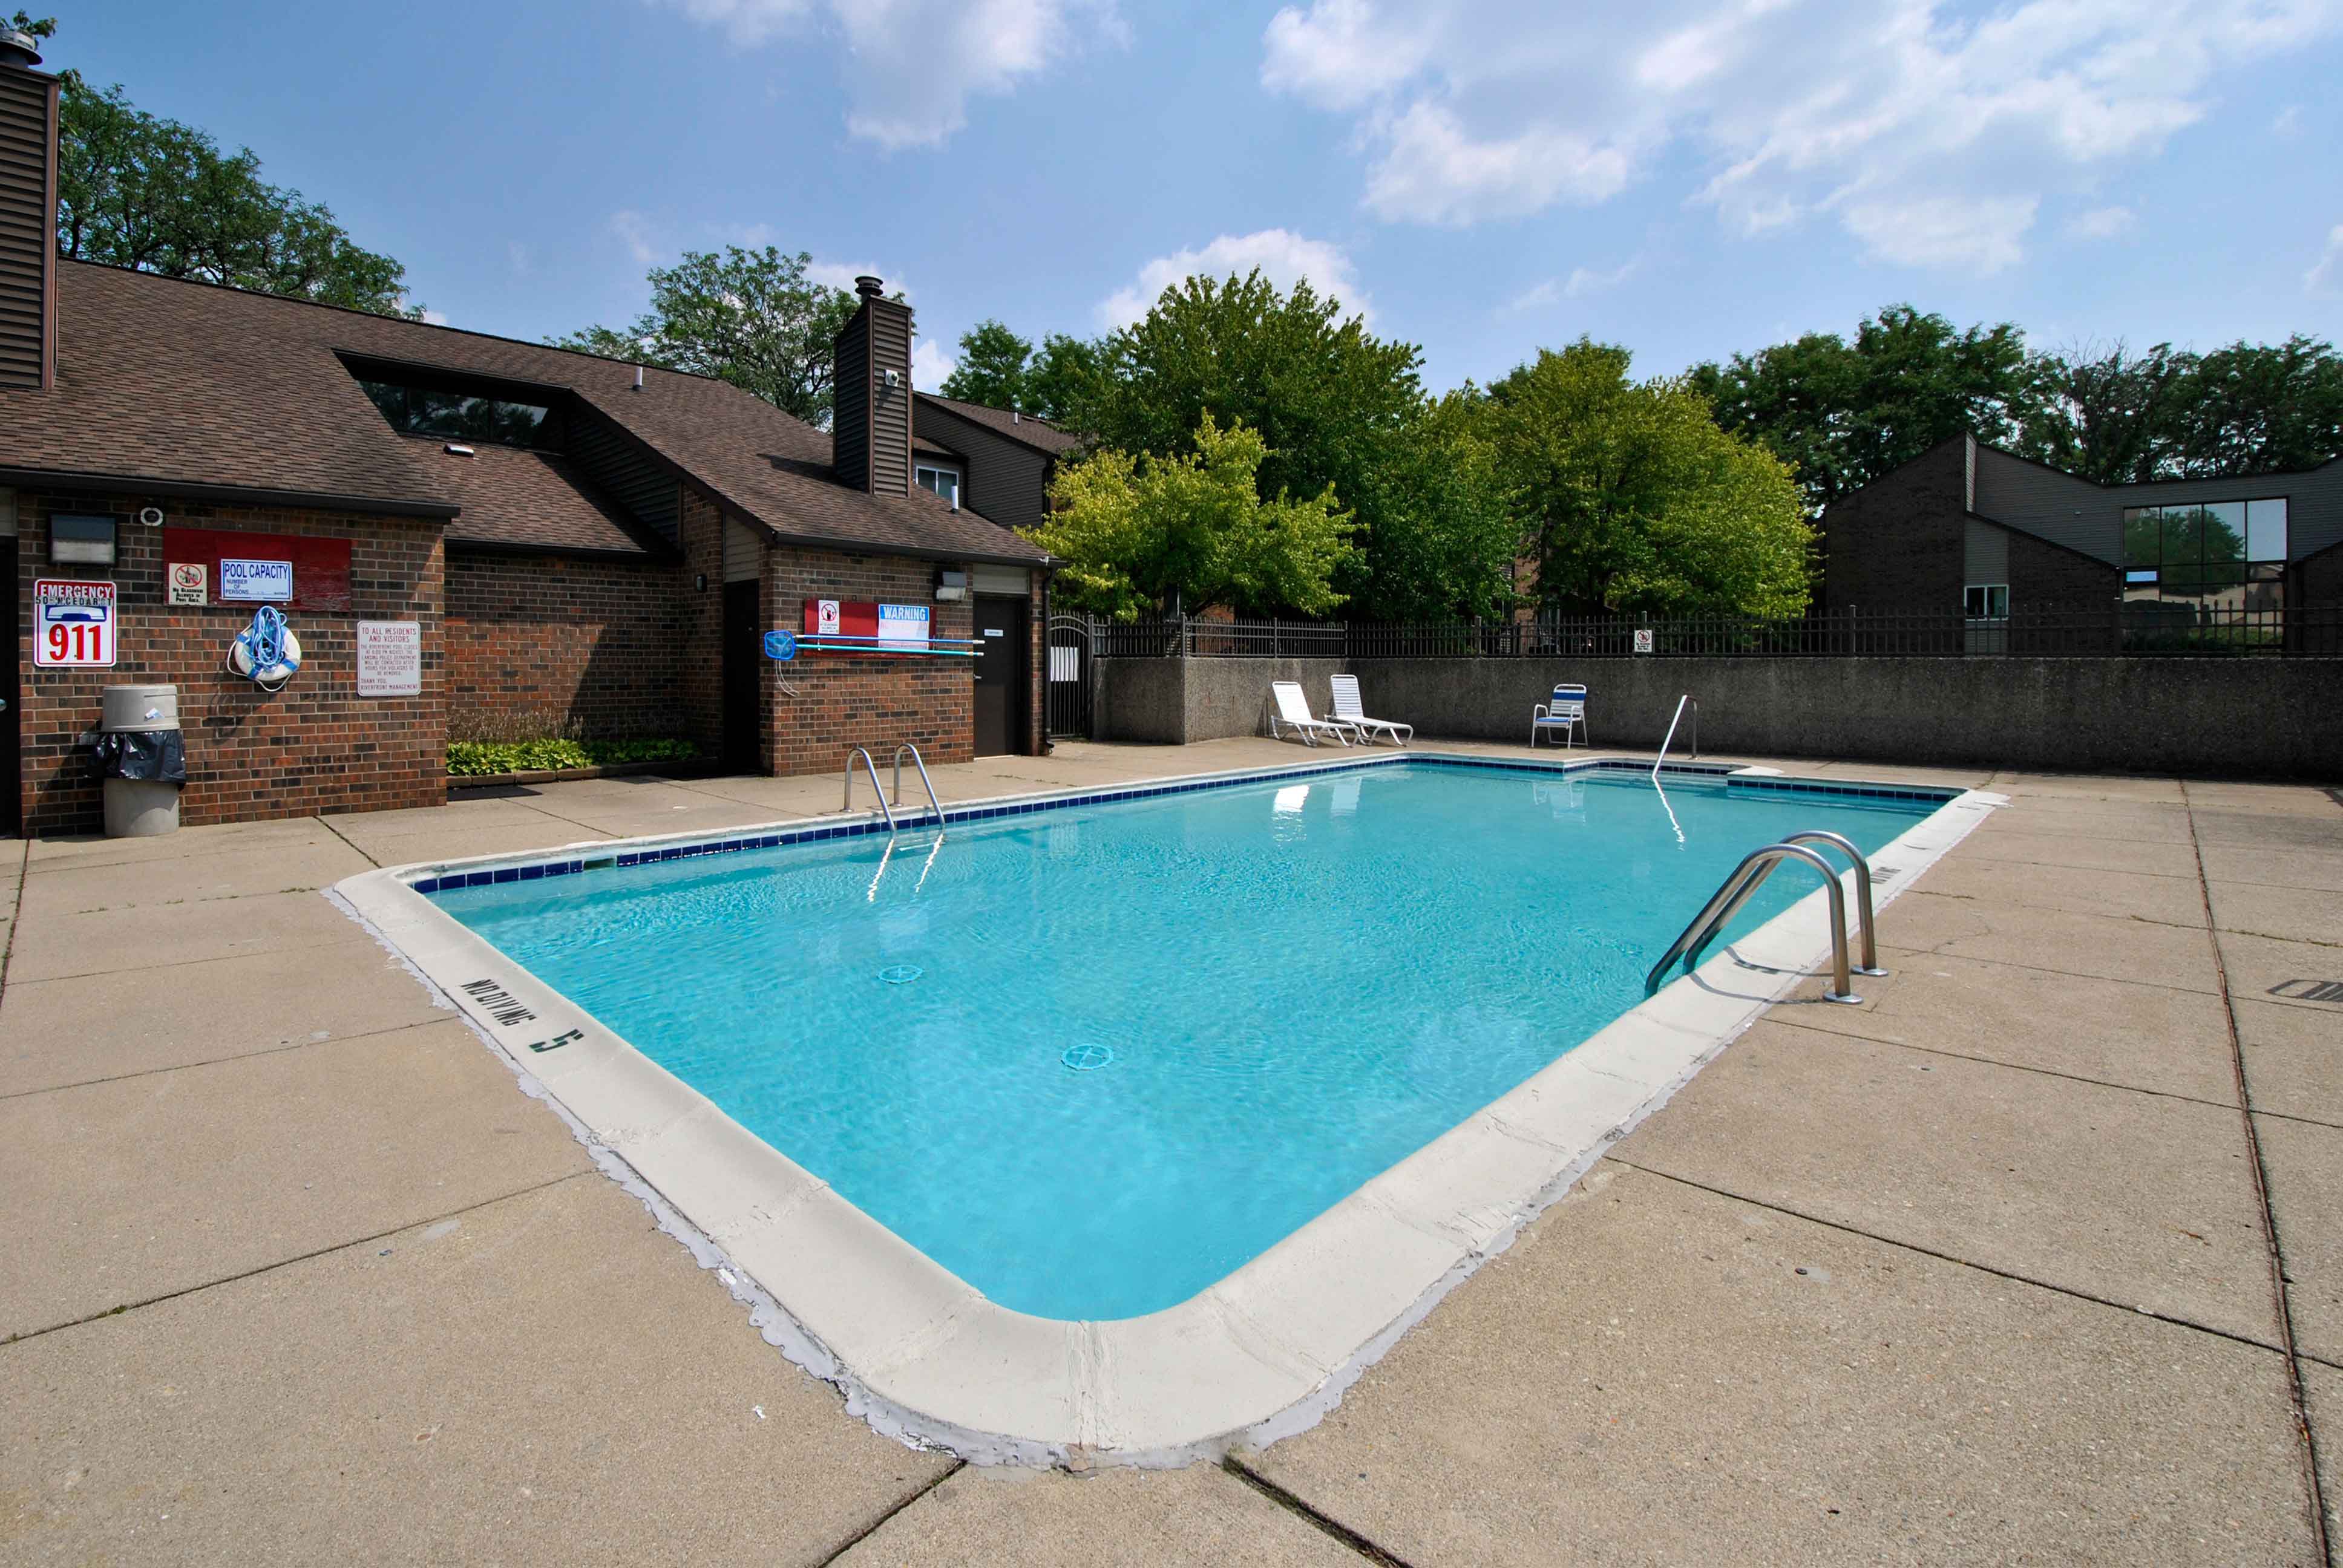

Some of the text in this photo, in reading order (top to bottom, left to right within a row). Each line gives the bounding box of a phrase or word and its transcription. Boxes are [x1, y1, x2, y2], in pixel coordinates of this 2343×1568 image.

[224, 563, 288, 579] POOL CAPACITY
[41, 584, 112, 598] EMERGENCY
[883, 607, 926, 620] WARNING
[49, 624, 101, 661] 911
[460, 979, 537, 1027] NO DIVING
[528, 1028, 585, 1053] 5
